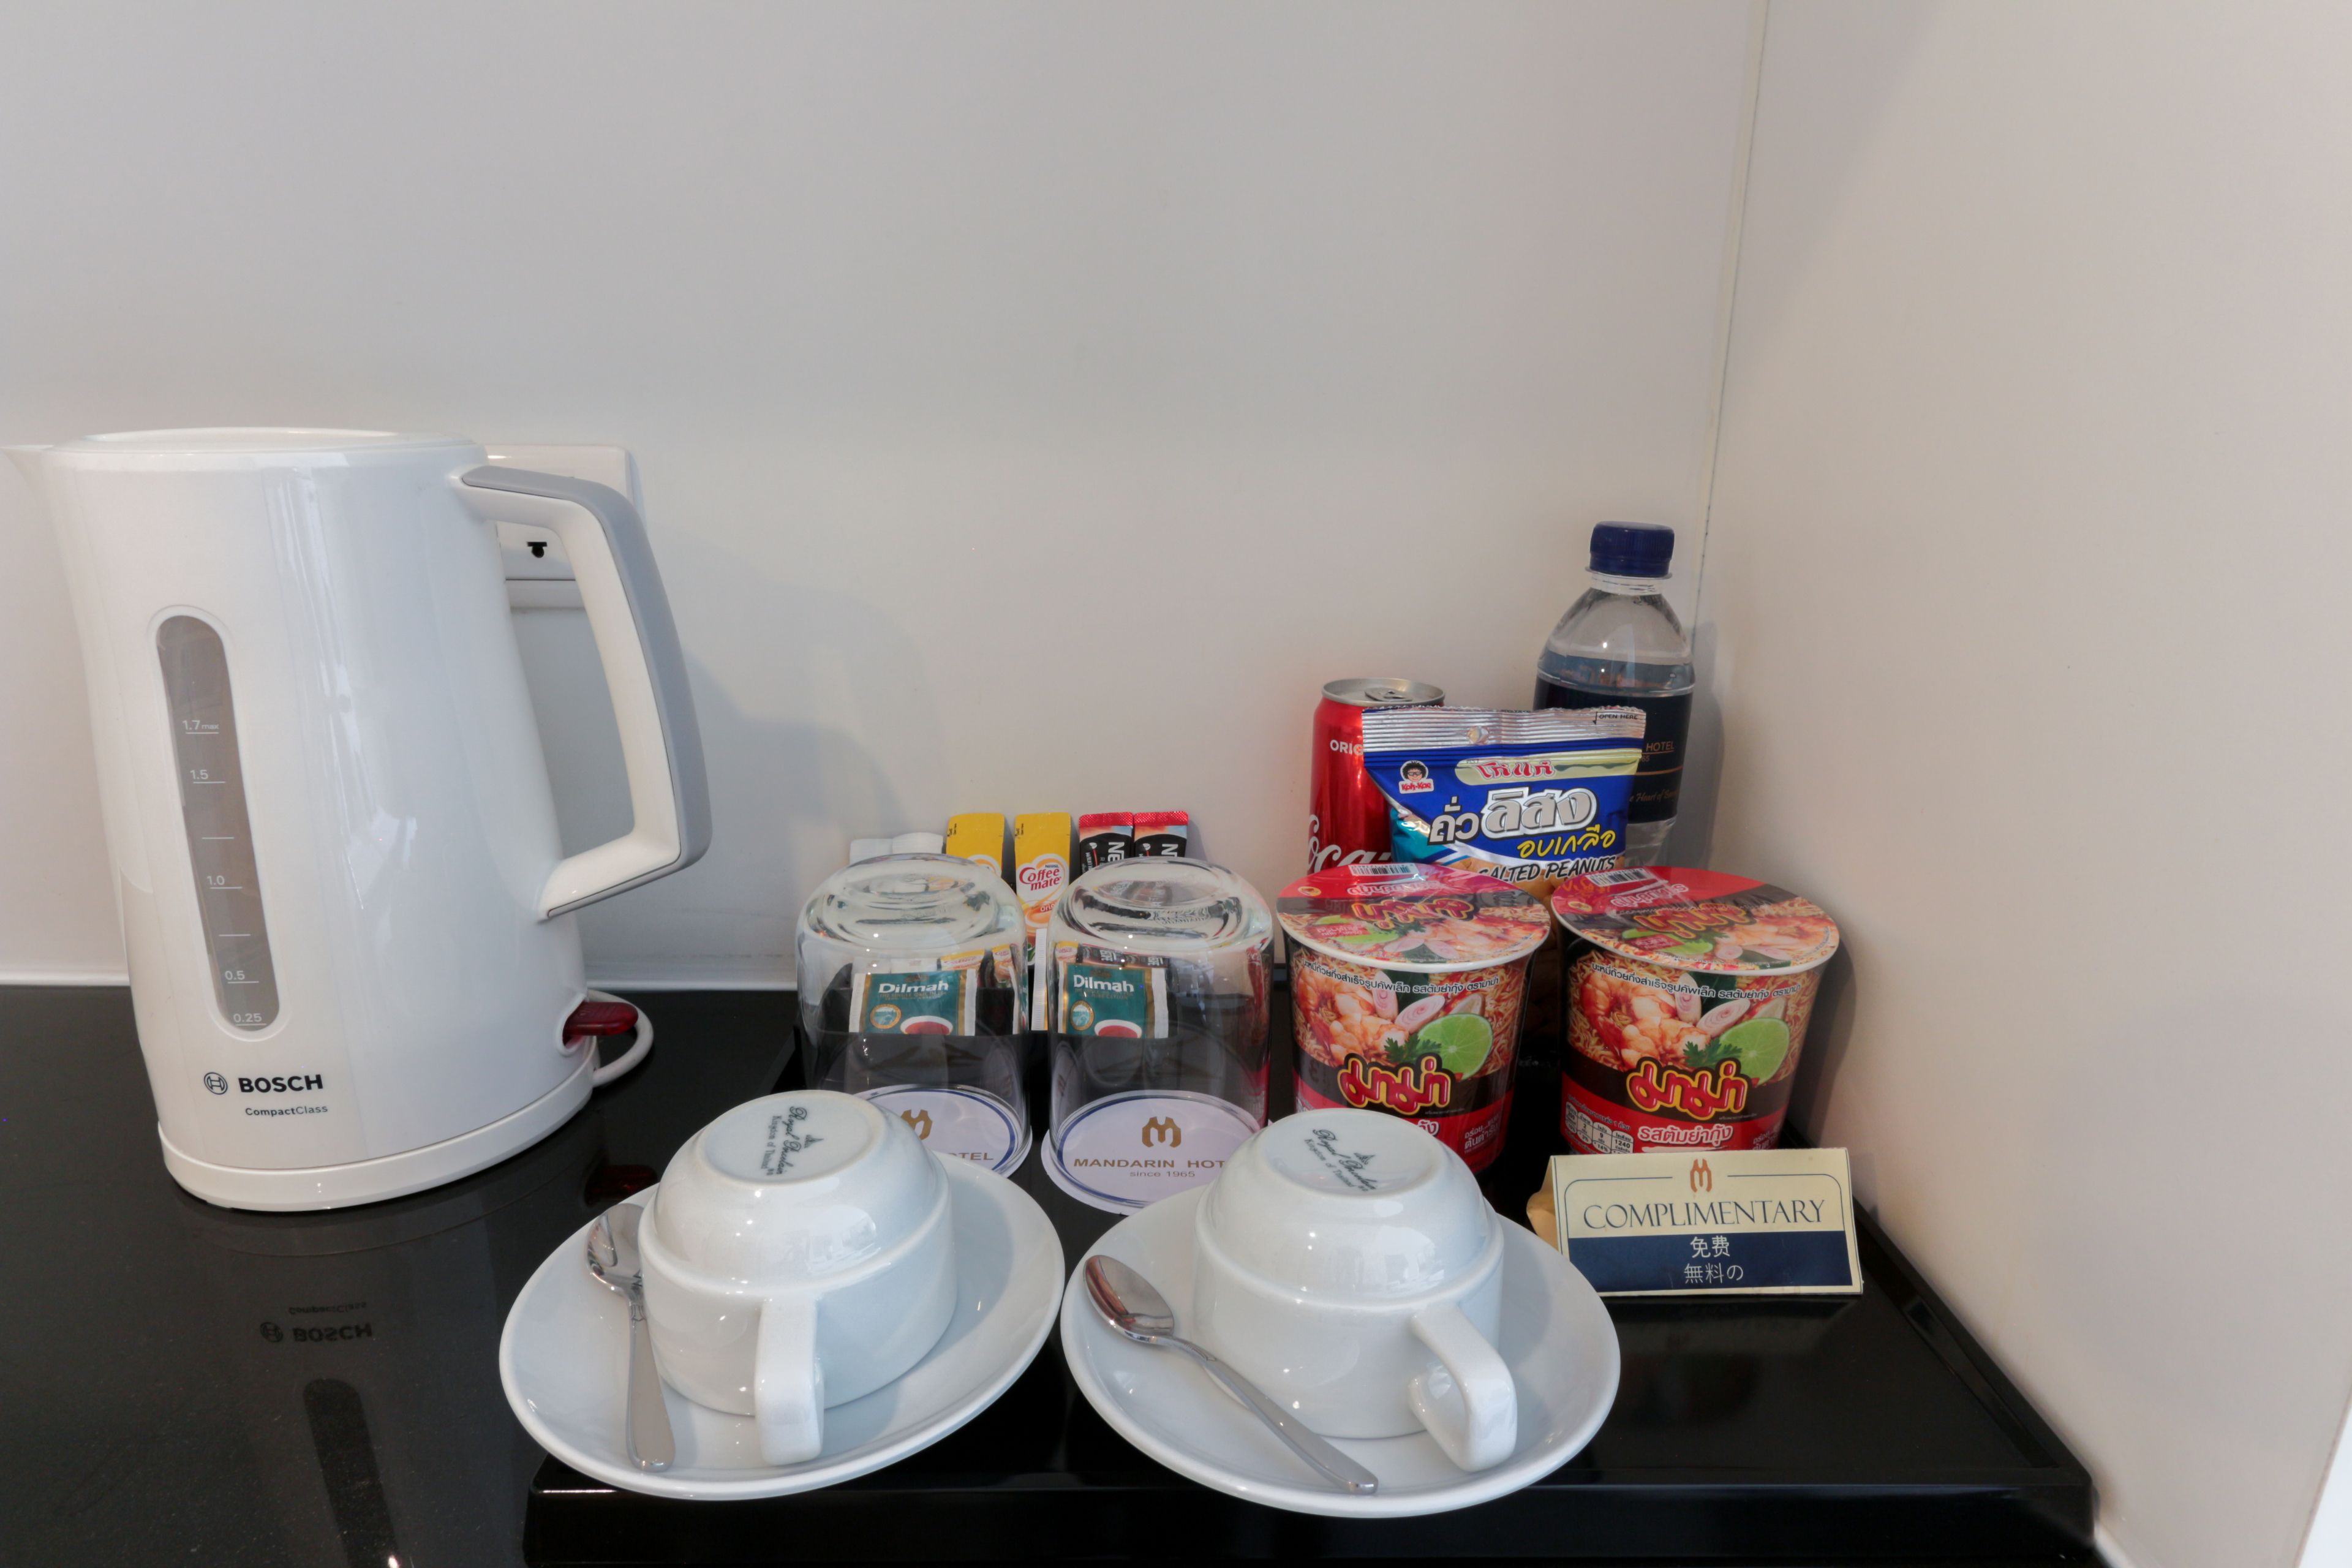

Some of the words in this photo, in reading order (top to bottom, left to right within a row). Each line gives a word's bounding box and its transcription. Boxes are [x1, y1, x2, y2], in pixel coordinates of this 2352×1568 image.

[1646, 741, 1675, 752] HOTEL
[189, 769, 209, 781] 1.5
[1545, 856, 1616, 878] PEANUTS
[206, 875, 225, 886] 1.0
[1019, 867, 1060, 884] Coffee
[1030, 877, 1060, 891] mate
[224, 970, 245, 981] 0.5
[1073, 974, 1134, 992] Dilmah
[878, 980, 949, 993] Dilmah
[233, 1012, 262, 1023] 0.25
[238, 1074, 323, 1093] BOSCH
[1337, 1056, 1451, 1115] มาม่า
[1626, 1060, 1748, 1121] มาม่า
[244, 1104, 328, 1117] CompactClass
[1637, 1123, 1734, 1147] รสต้มยำกุ้ง
[1615, 1139, 1630, 1148] 1240
[1073, 1158, 1175, 1168] MANDARIN
[1583, 1199, 1826, 1230] COMPLIMENTARY
[1690, 1235, 1731, 1259] 免费
[1683, 1263, 1744, 1285] 無料の
